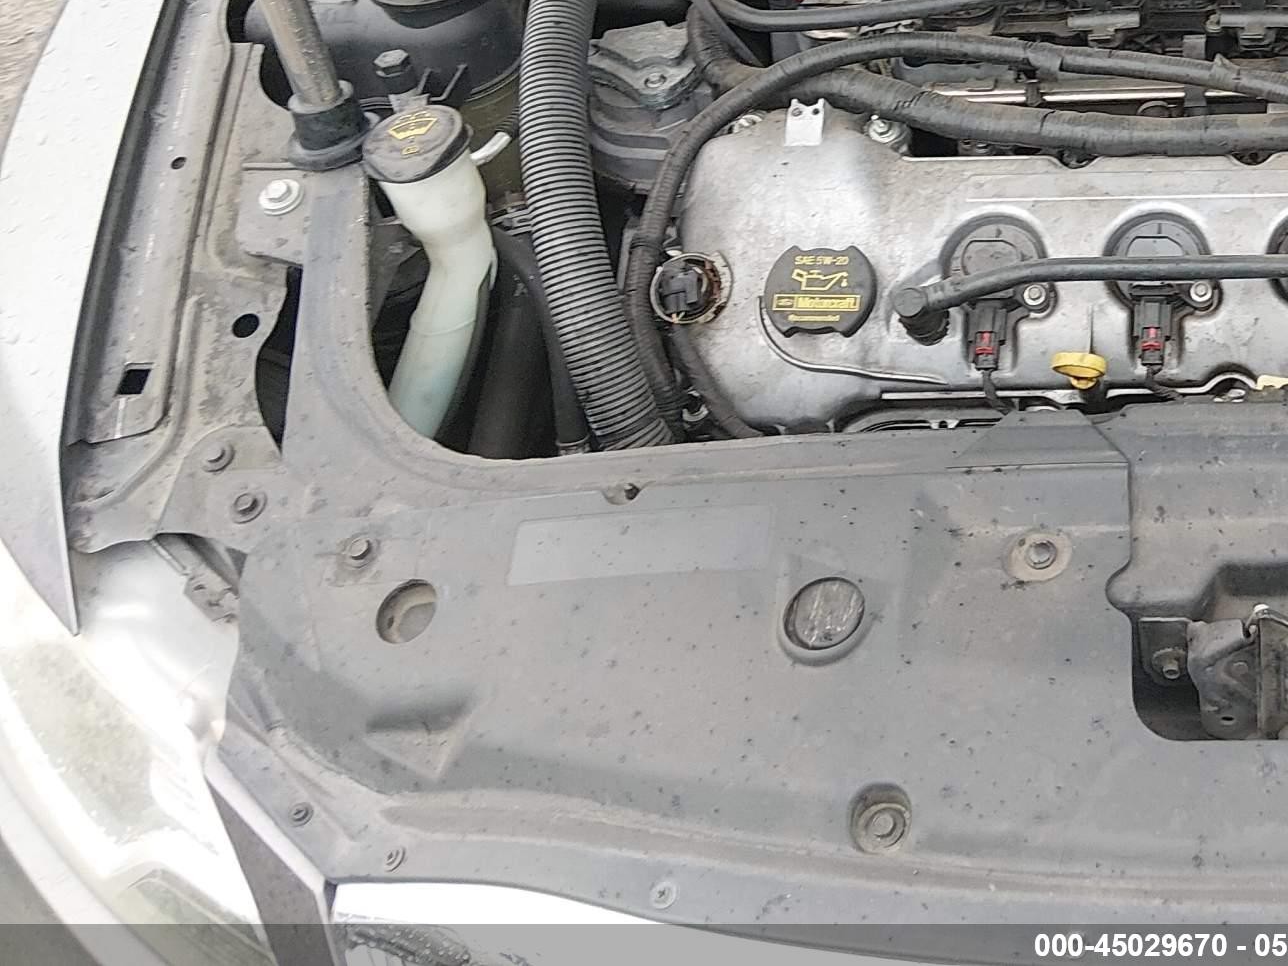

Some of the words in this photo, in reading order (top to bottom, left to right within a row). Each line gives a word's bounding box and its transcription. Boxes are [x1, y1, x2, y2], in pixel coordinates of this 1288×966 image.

[794, 255, 815, 265] SAE
[816, 255, 849, 265] 5W-20
[797, 296, 856, 309] Motorcraft
